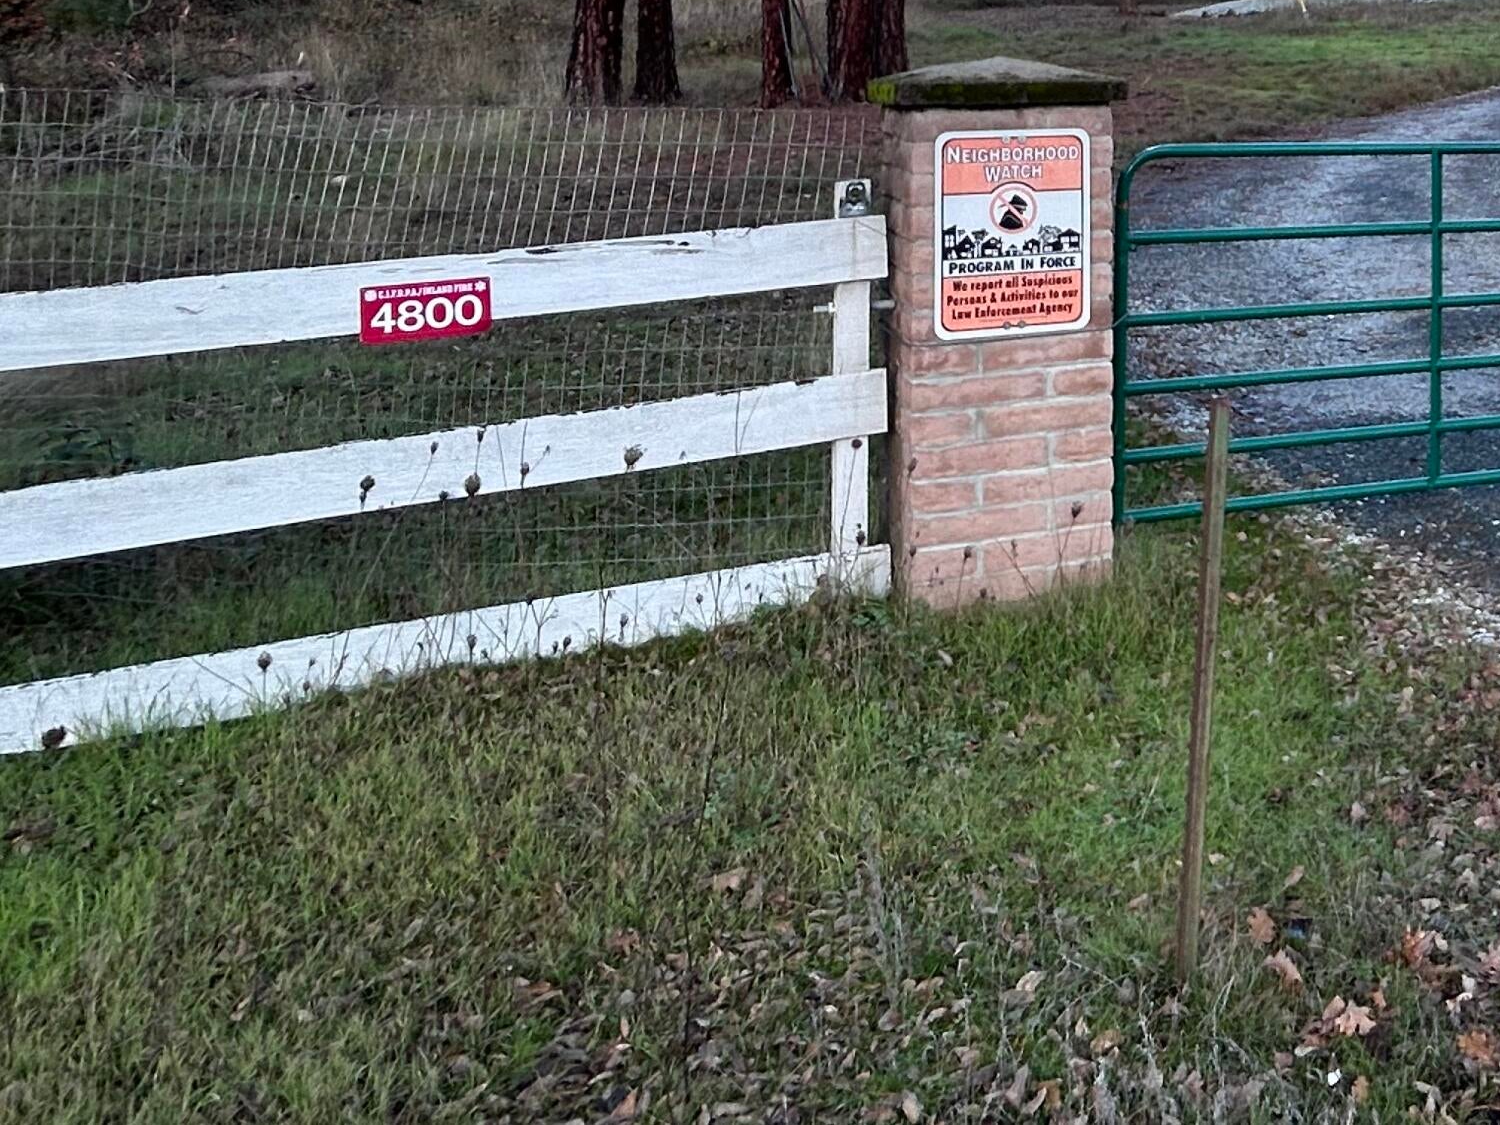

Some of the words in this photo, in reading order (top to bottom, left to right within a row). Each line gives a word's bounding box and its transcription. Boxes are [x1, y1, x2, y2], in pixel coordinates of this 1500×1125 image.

[947, 146, 1079, 163] NEIGHBORHOOD
[985, 165, 1042, 182] WATCH
[949, 260, 1014, 274] PROGRAM
[1021, 257, 1034, 270] IN
[1040, 256, 1076, 269] FORCE
[953, 280, 968, 292] We
[971, 279, 1003, 292] report
[1005, 276, 1019, 288] all
[1021, 273, 1073, 287] Suspicious
[947, 294, 987, 307] Persons
[990, 292, 997, 303] &
[1000, 288, 1046, 302] Activities
[1049, 289, 1059, 299] to
[1061, 289, 1079, 298] our
[370, 294, 483, 334] 4800
[952, 308, 972, 320] Law
[975, 304, 1036, 318] Enforcement
[1039, 302, 1073, 315] Agency
